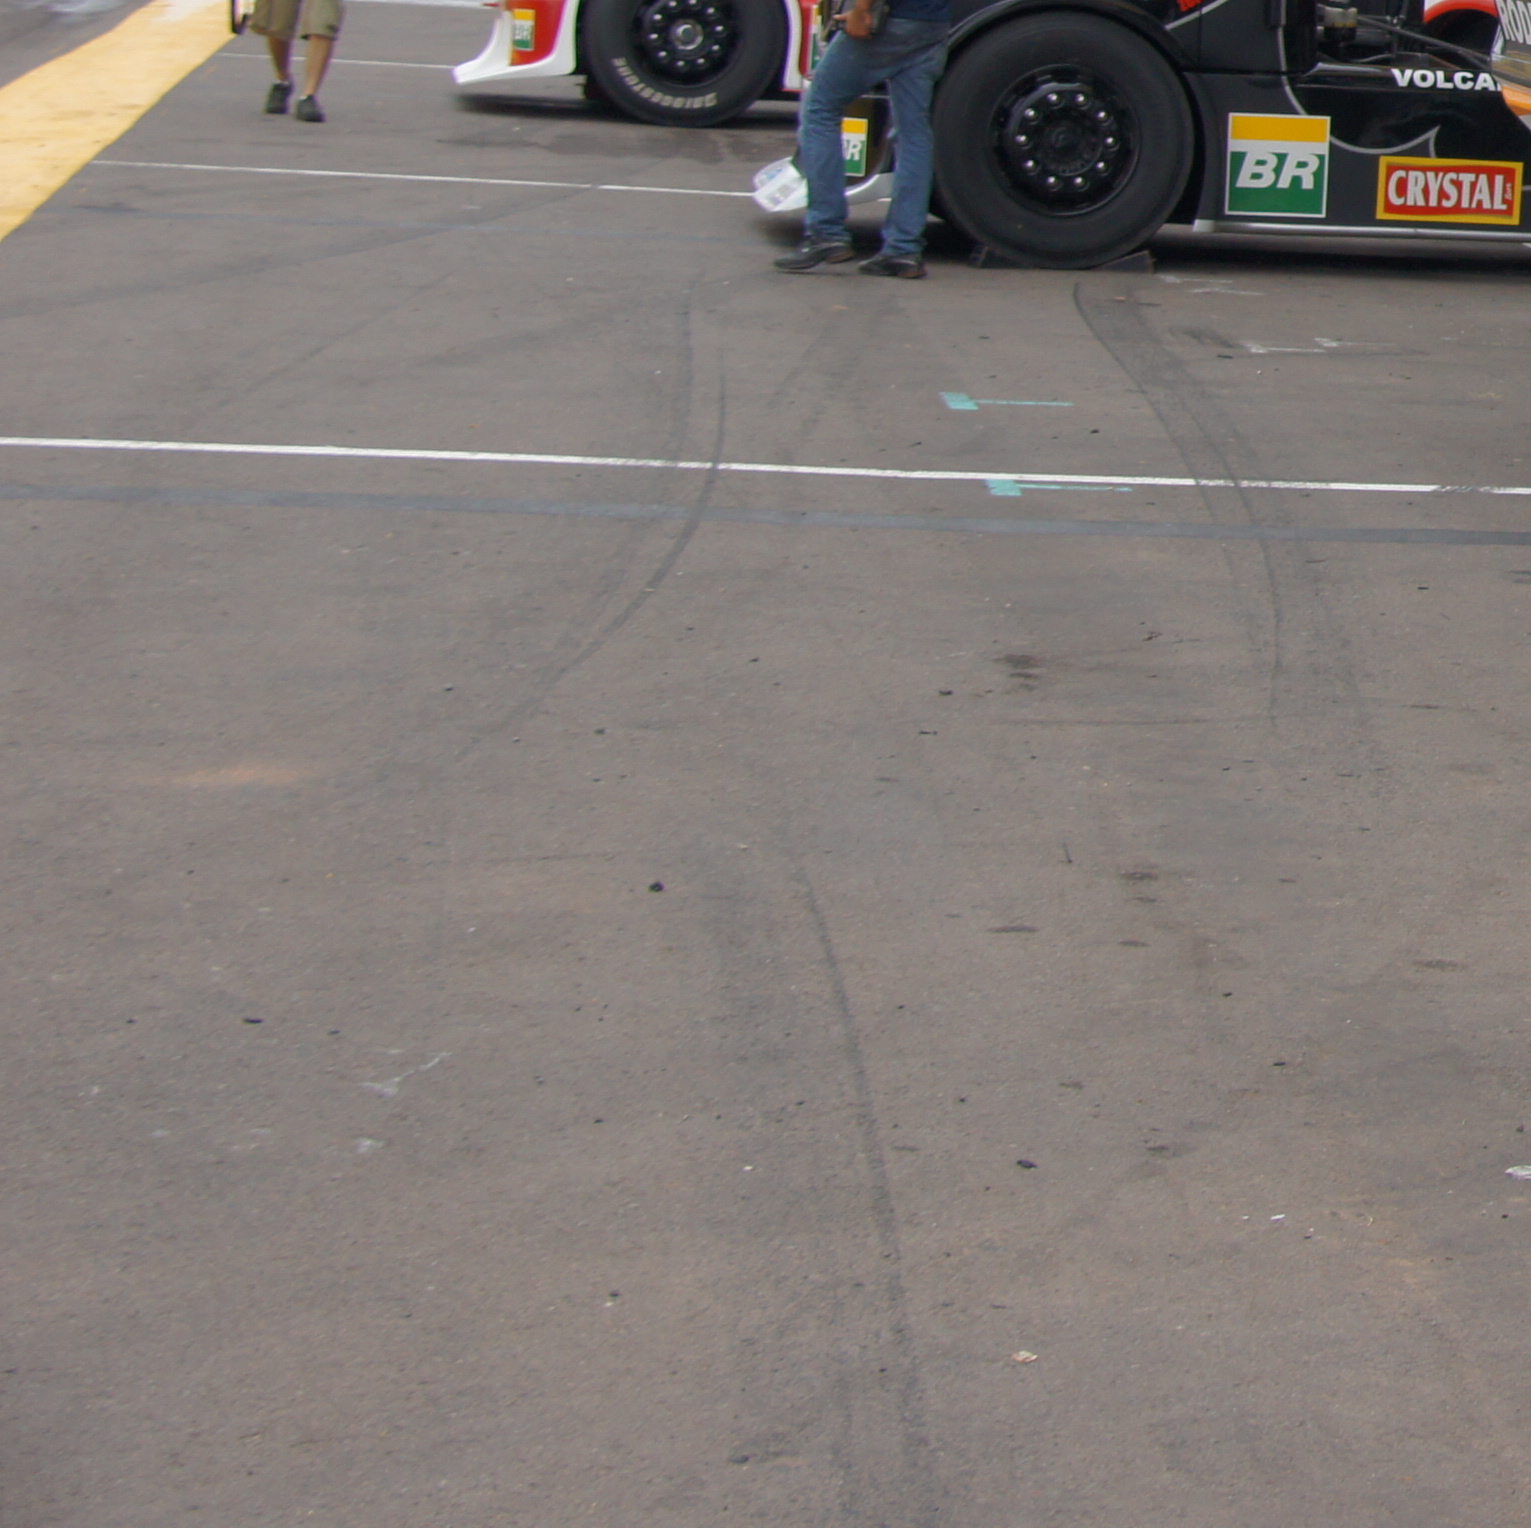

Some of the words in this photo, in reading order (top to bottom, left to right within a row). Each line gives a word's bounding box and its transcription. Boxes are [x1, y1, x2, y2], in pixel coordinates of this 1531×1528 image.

[1391, 69, 1501, 92] VOLCA
[1235, 149, 1317, 191] BR
[1387, 170, 1508, 211] CRYSTAL
